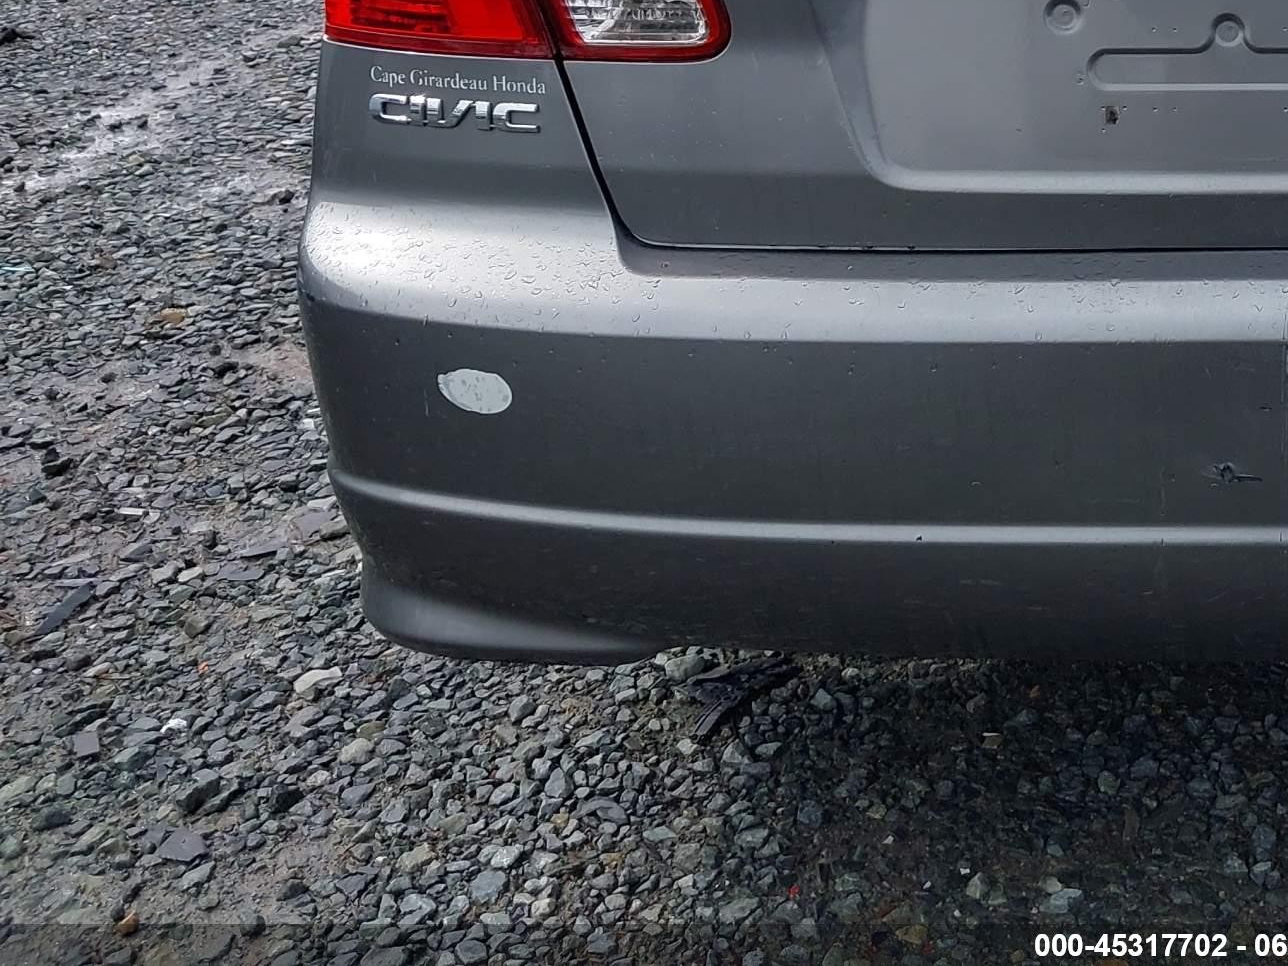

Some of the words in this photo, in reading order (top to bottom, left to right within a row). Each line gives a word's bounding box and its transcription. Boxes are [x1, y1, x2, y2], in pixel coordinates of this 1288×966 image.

[370, 65, 406, 87] Cape
[409, 69, 487, 91] Girardeau
[493, 75, 546, 94] Honda
[369, 92, 541, 133] CIVIC
